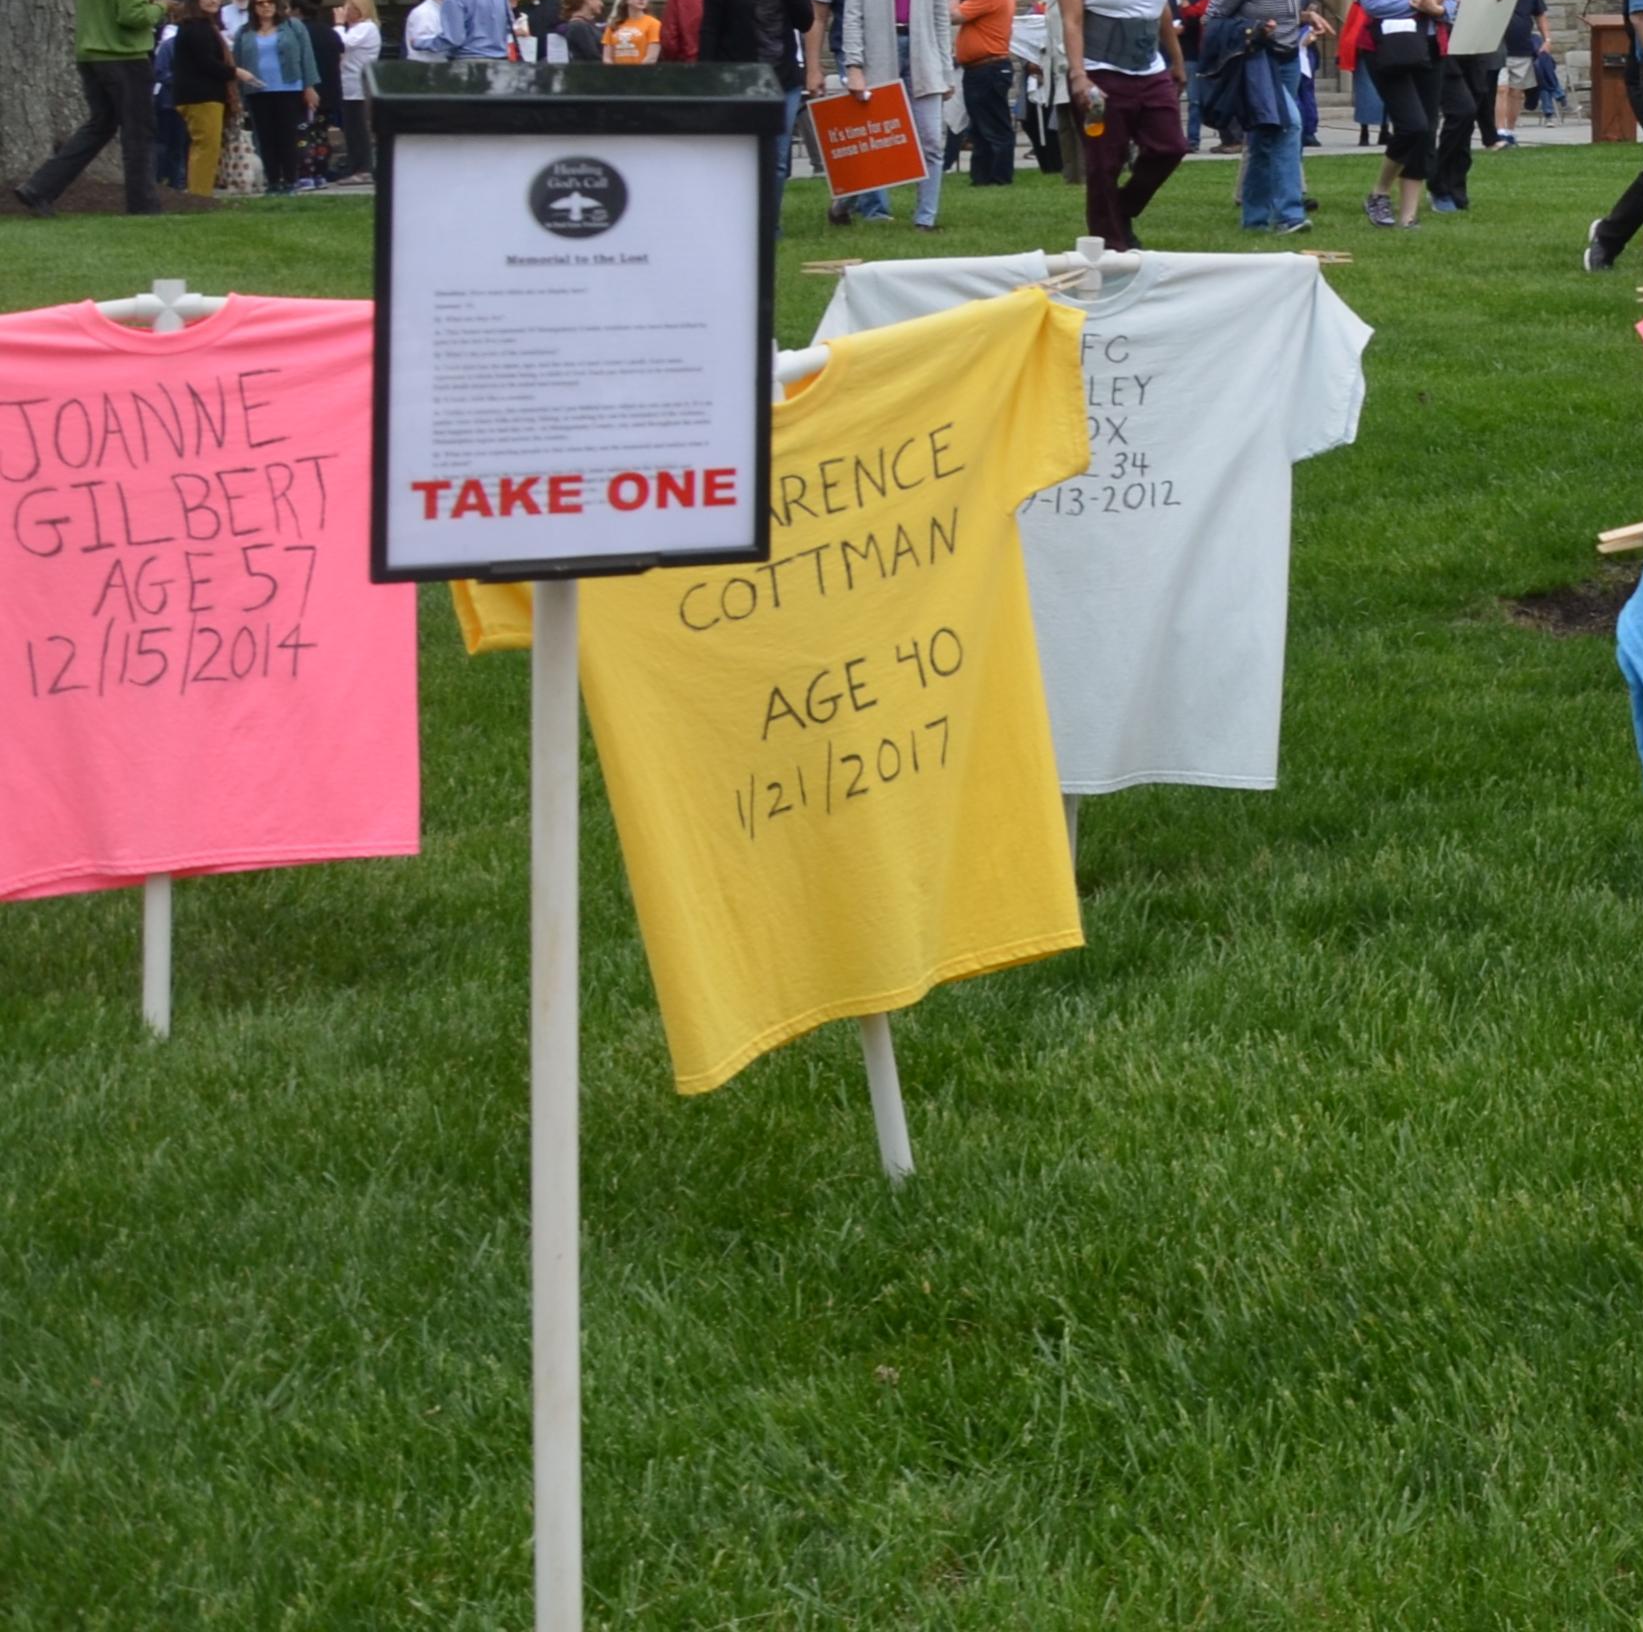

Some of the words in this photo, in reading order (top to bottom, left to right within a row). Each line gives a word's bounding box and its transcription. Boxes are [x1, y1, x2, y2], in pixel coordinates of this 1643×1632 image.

[828, 127, 845, 144] It's
[844, 125, 867, 140] time
[867, 120, 881, 134] for
[883, 118, 901, 134] gun
[831, 144, 859, 160] sense
[858, 141, 869, 153] in
[869, 133, 908, 151] America
[506, 254, 571, 266] Memorial
[575, 254, 589, 265] to
[593, 253, 615, 264] the
[620, 252, 649, 264] Lost
[0, 369, 292, 483] JOANNE
[1110, 451, 1151, 480] 34
[13, 453, 339, 557] GILBERT
[411, 474, 584, 520] TAKE
[607, 468, 738, 511] ONE
[92, 550, 215, 622] AGE
[242, 543, 318, 618] 57
[678, 508, 958, 632] COTTMAN
[27, 616, 319, 698] 12/15/2014
[761, 656, 879, 741] AGE
[896, 626, 965, 689] 40
[736, 715, 951, 841] 1/21/2017
